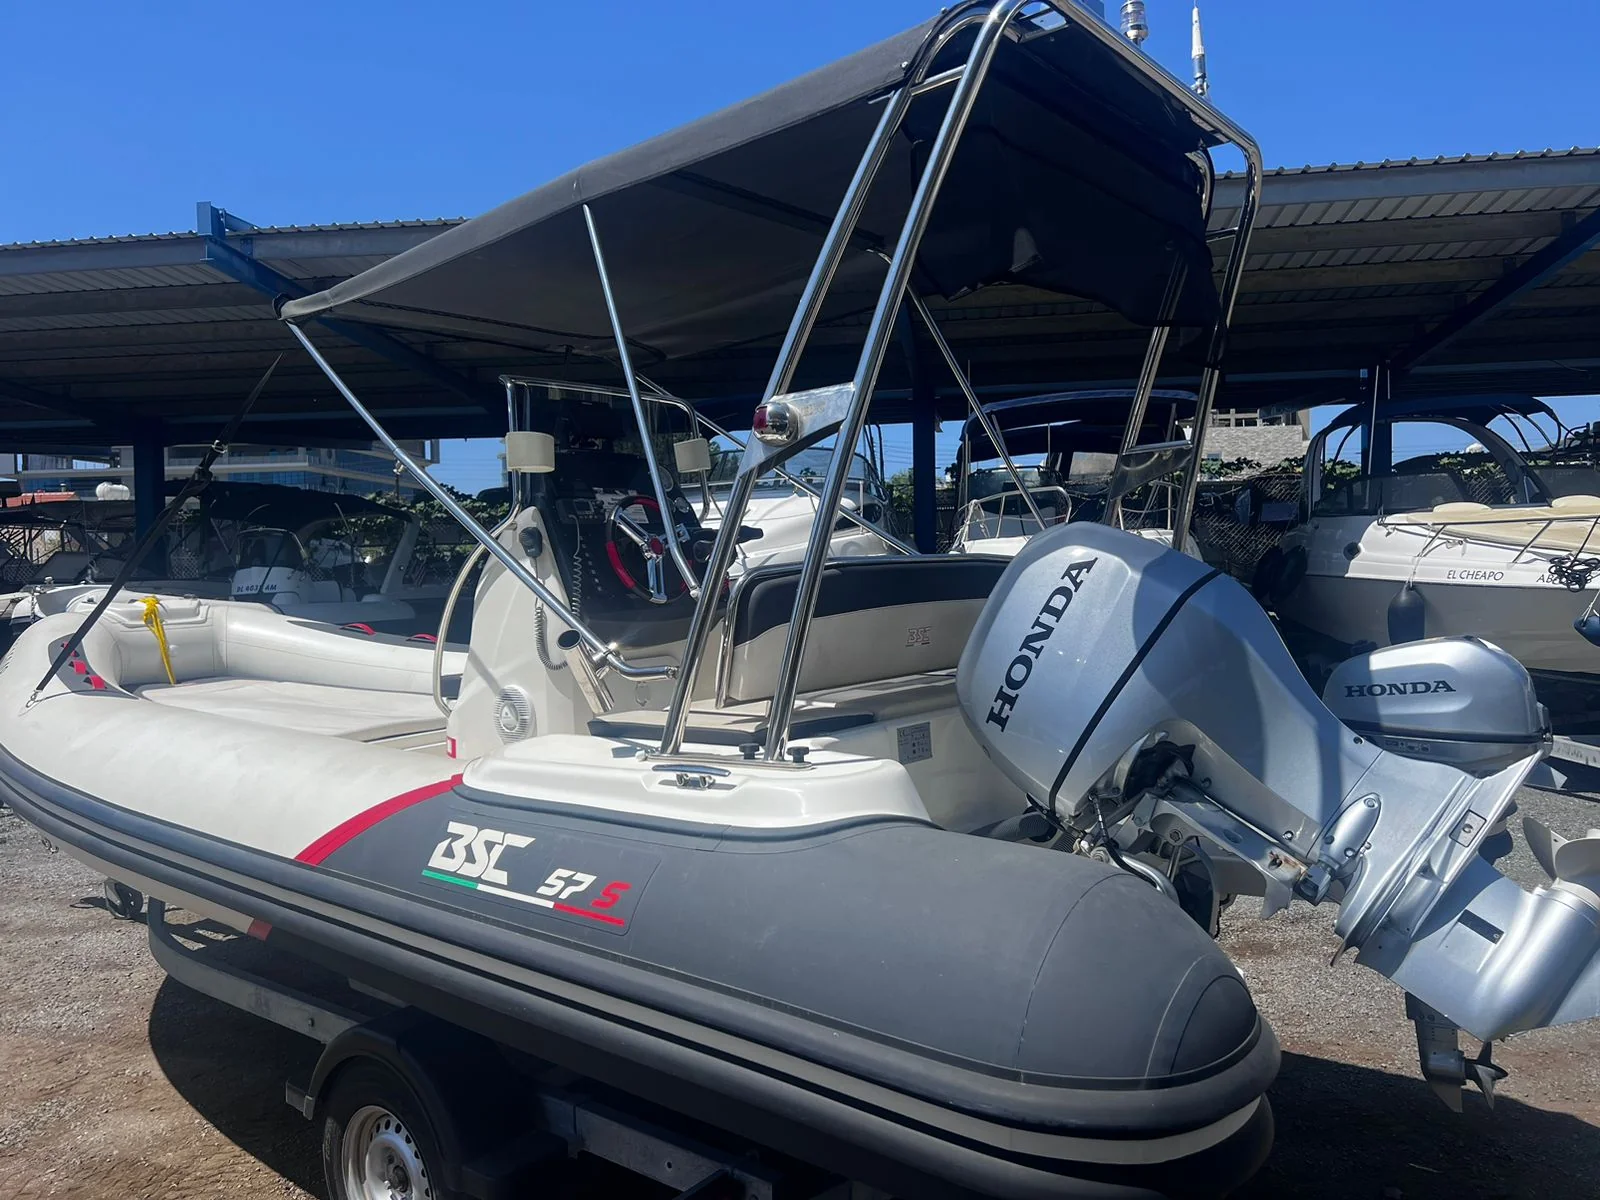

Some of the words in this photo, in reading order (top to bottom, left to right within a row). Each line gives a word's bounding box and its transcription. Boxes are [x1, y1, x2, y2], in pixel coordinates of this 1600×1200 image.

[1446, 569, 1456, 579] EL
[1459, 570, 1504, 581] CHEAPO
[986, 557, 1098, 732] HONDA
[1344, 680, 1456, 698] HONDA
[428, 821, 536, 885] BSC
[536, 868, 597, 899] 57
[591, 880, 632, 909] S
